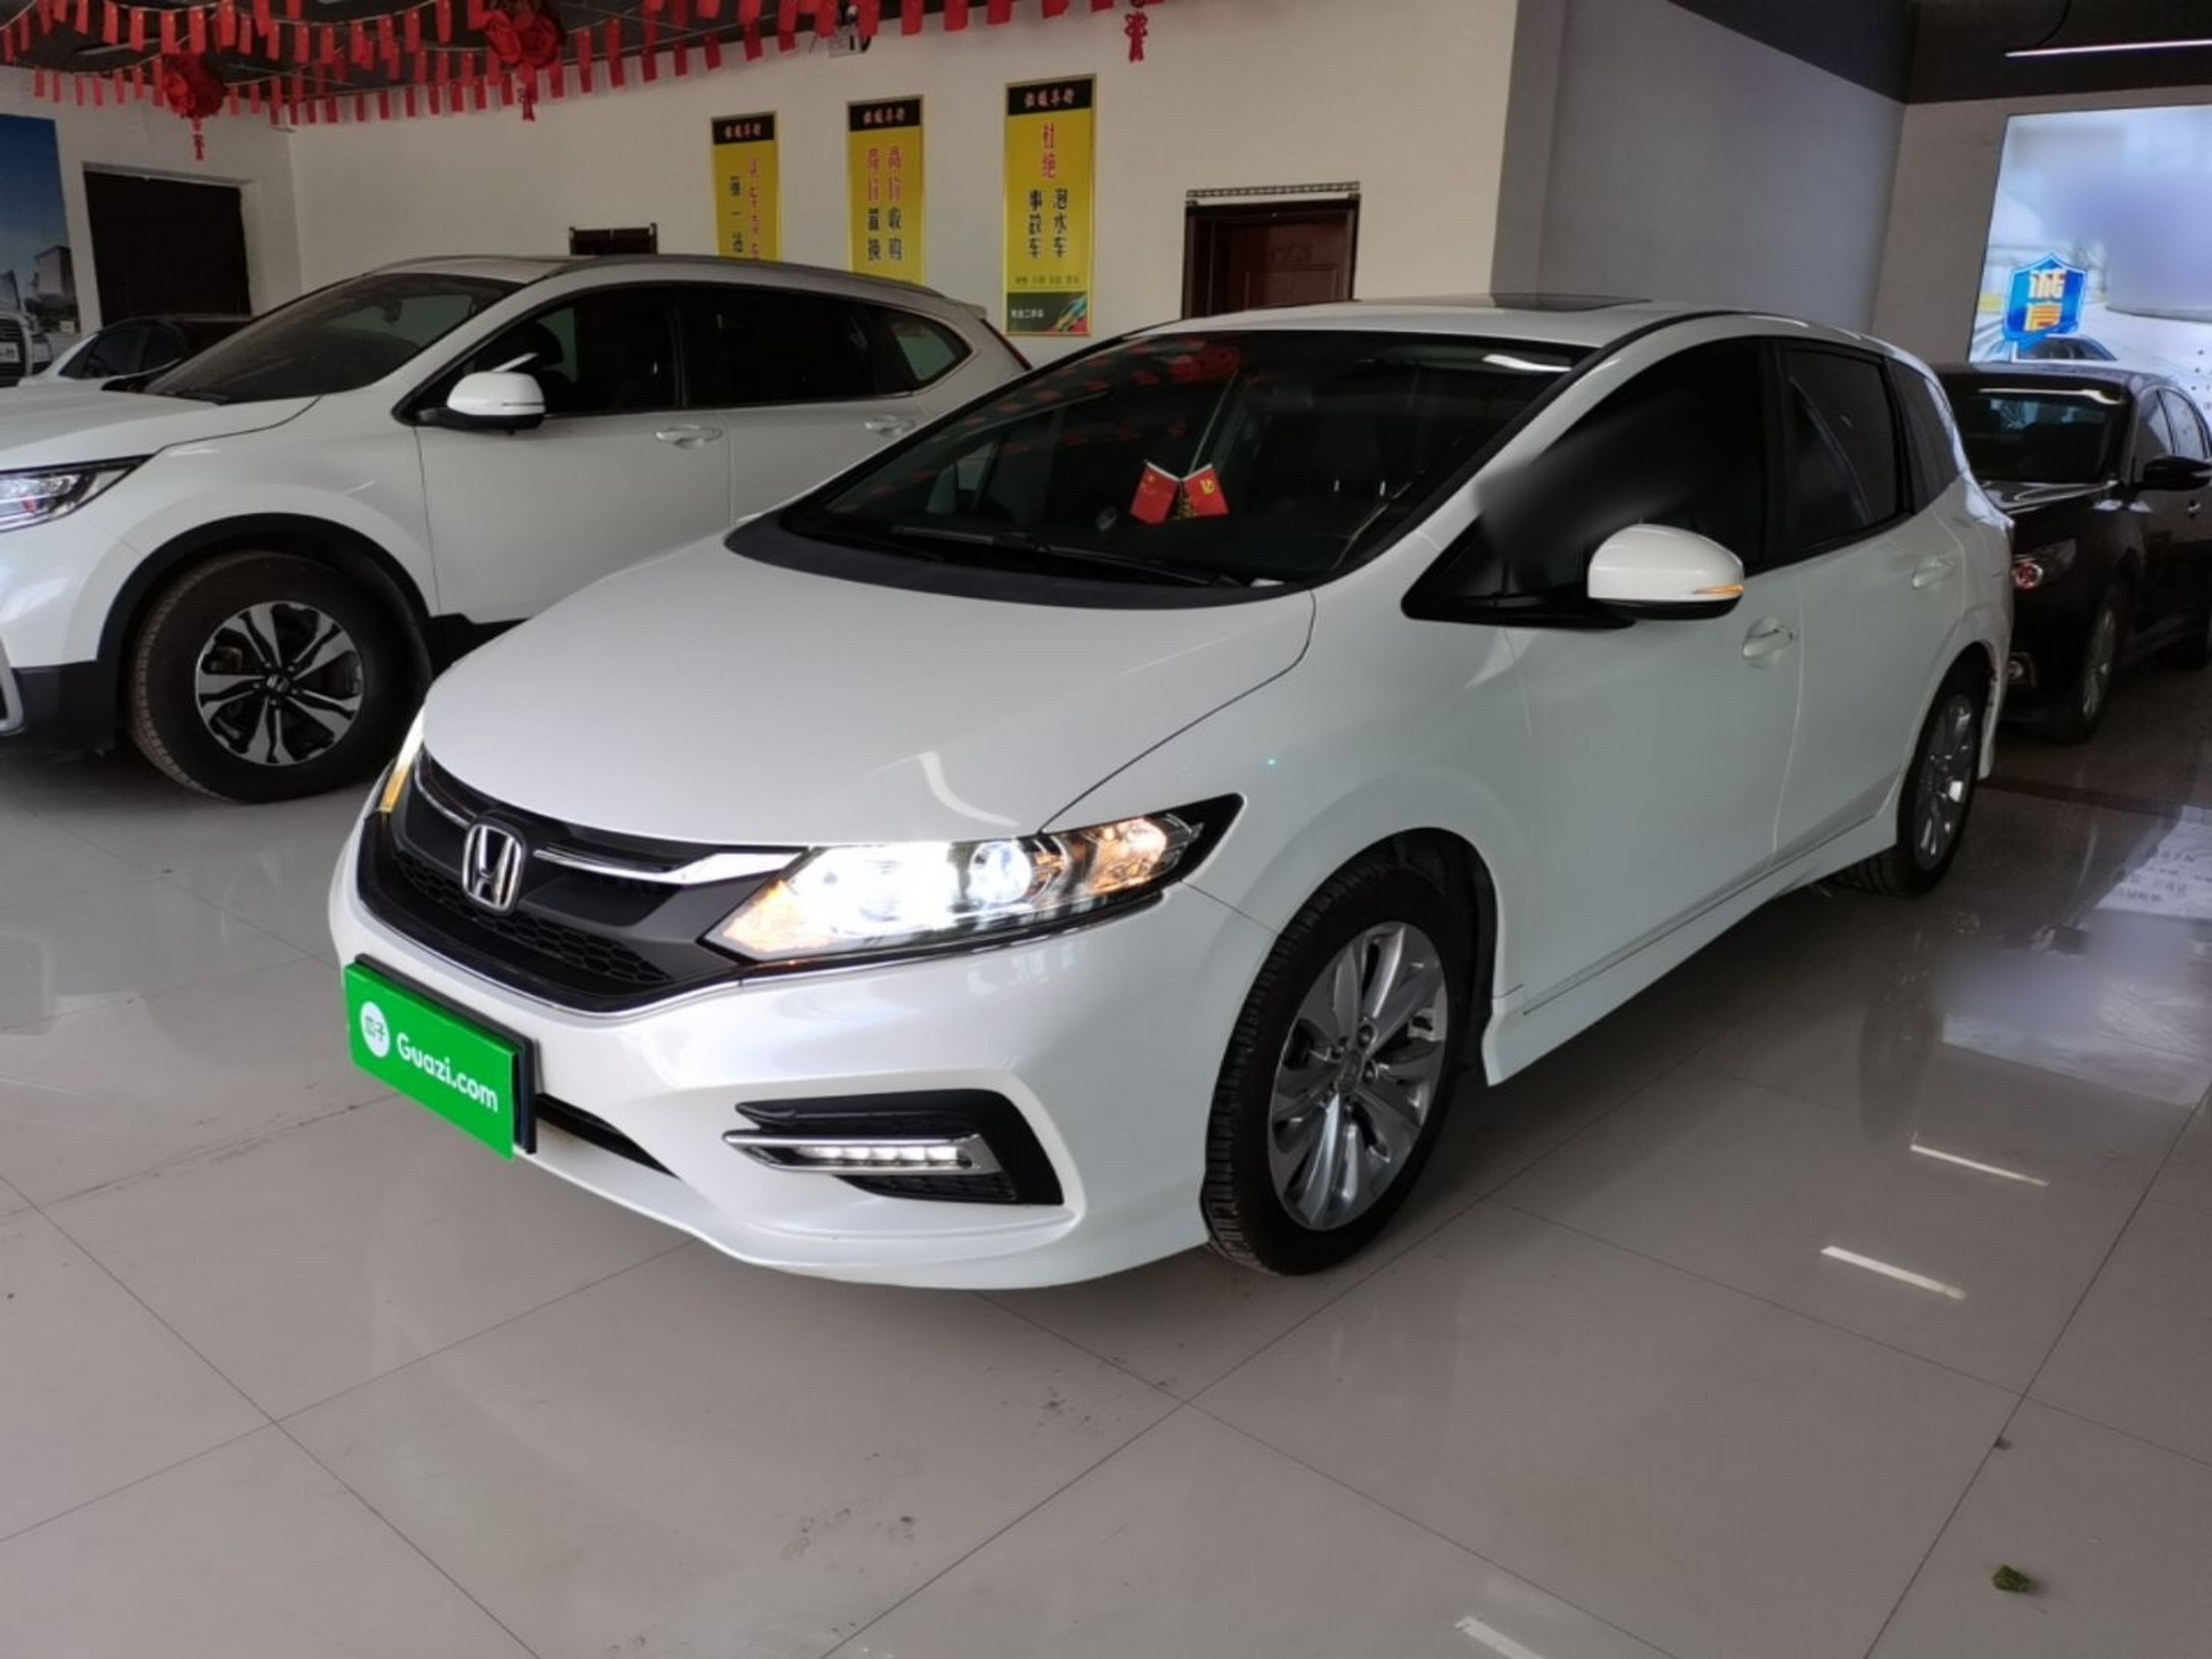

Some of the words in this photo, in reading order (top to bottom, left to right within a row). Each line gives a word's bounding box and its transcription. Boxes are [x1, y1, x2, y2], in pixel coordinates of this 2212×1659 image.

[1041, 122, 1056, 179] 杜绝
[1029, 189, 1043, 259] 事故车
[1053, 187, 1068, 258] 泡水车
[396, 1032, 499, 1113] Guazi.com
